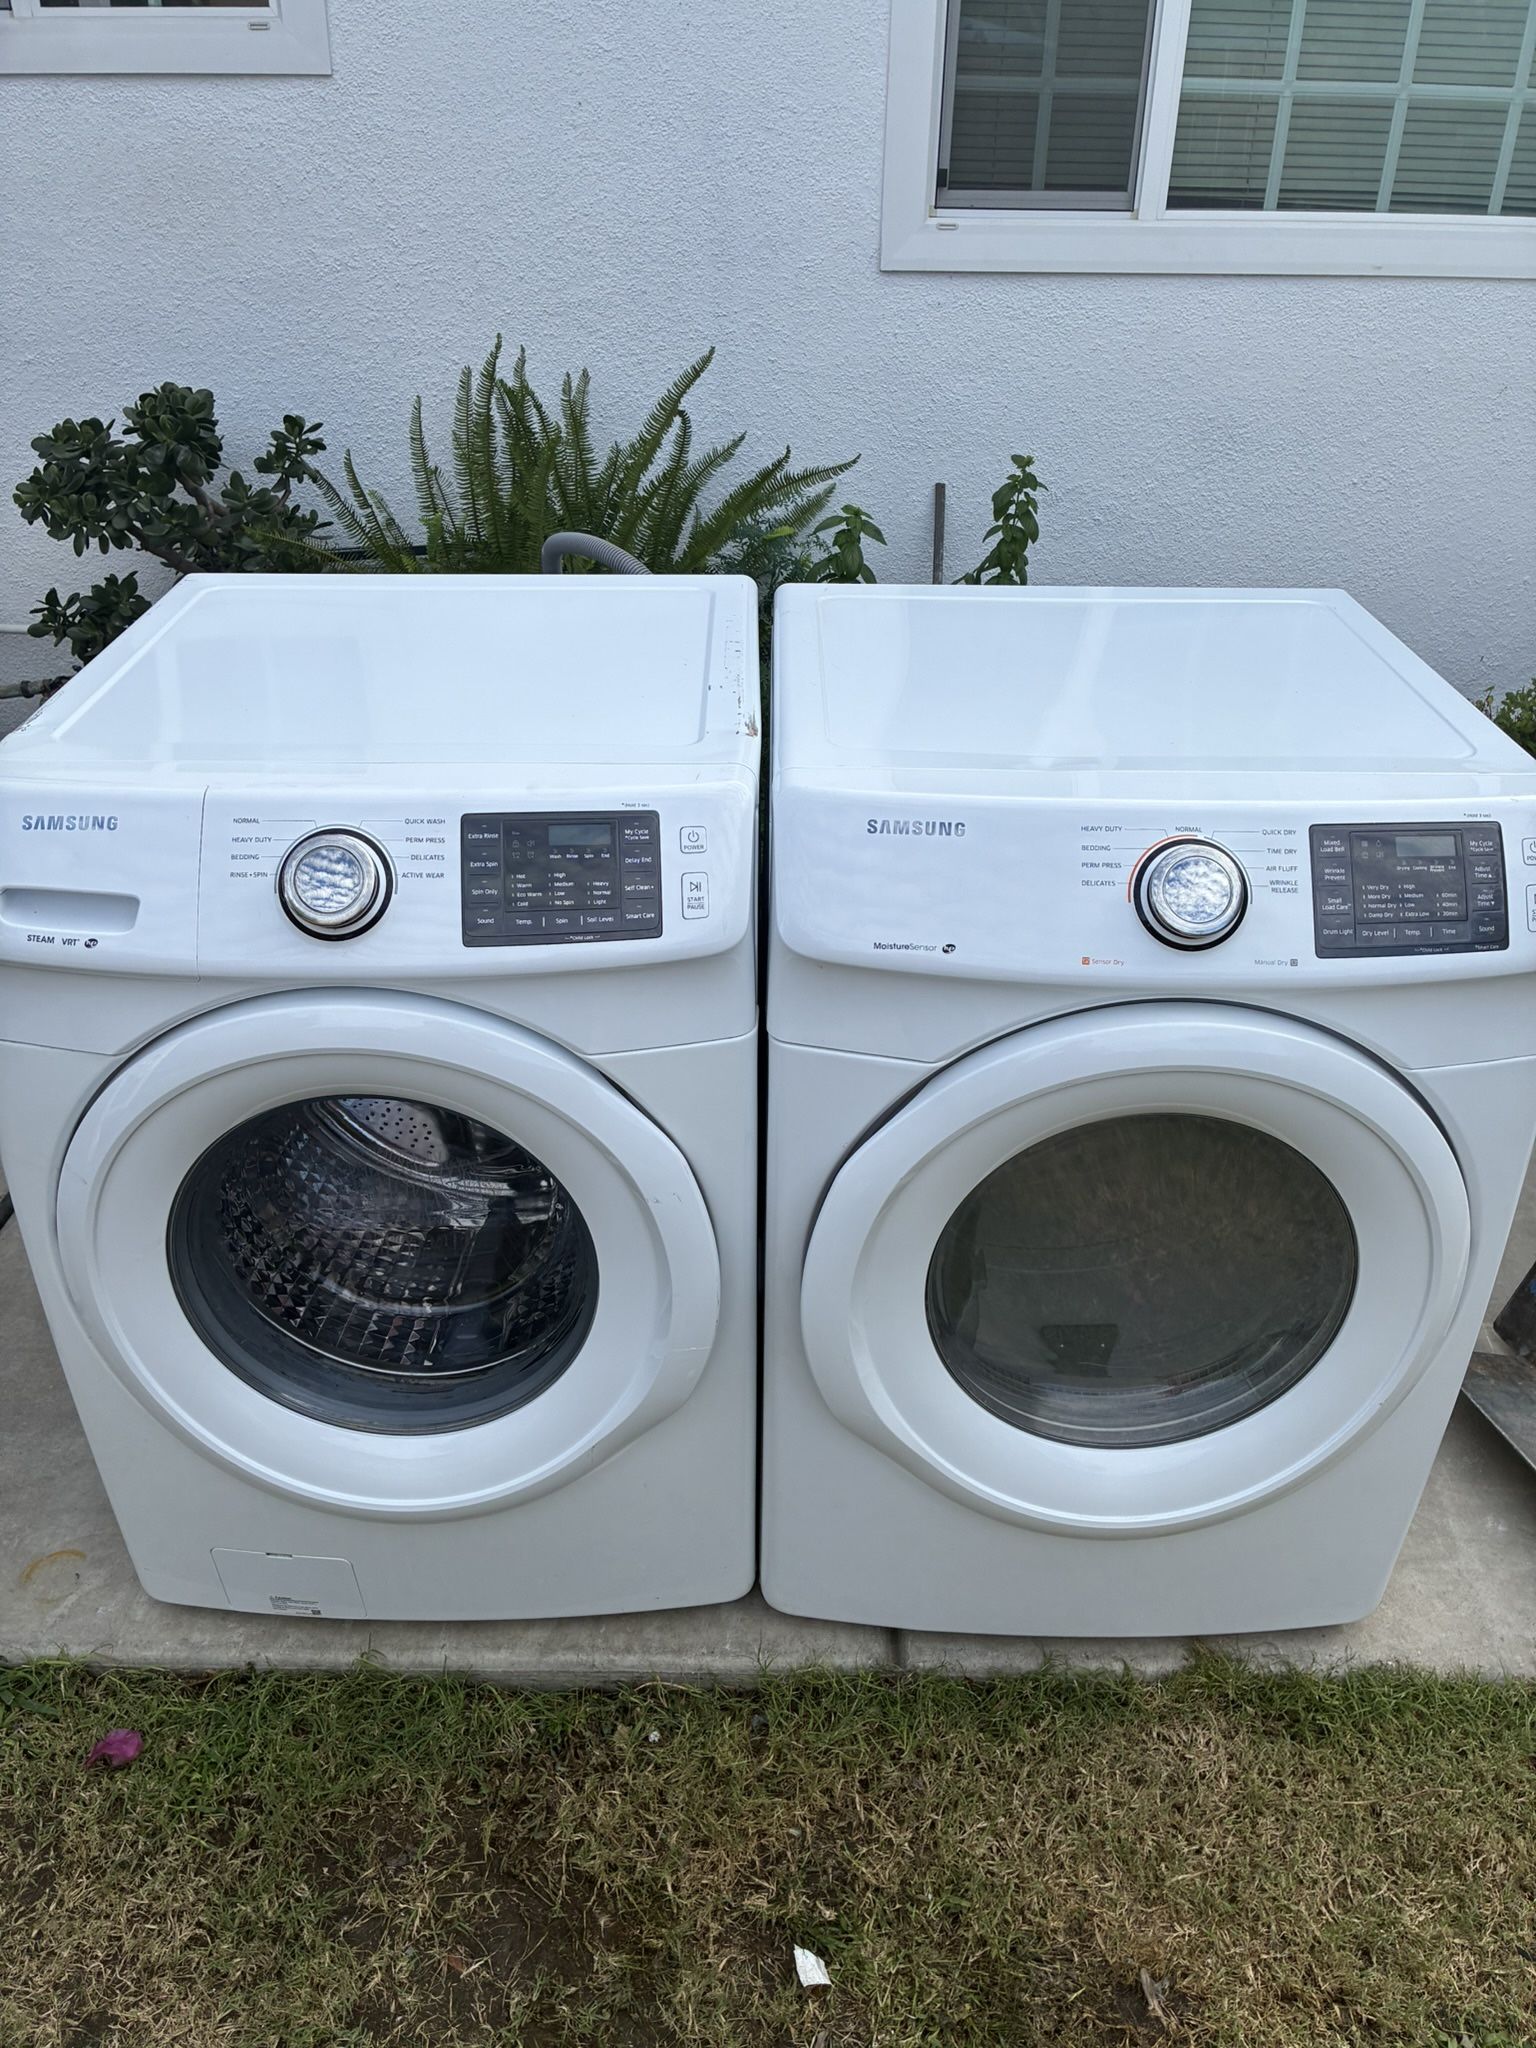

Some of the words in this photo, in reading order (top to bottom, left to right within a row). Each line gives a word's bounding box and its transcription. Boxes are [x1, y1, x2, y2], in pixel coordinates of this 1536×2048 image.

[22, 815, 119, 831] SAMSUNG
[866, 819, 966, 837] SAMSUNG
[27, 934, 55, 944] STEAM
[874, 942, 937, 951] MoistureSensor
